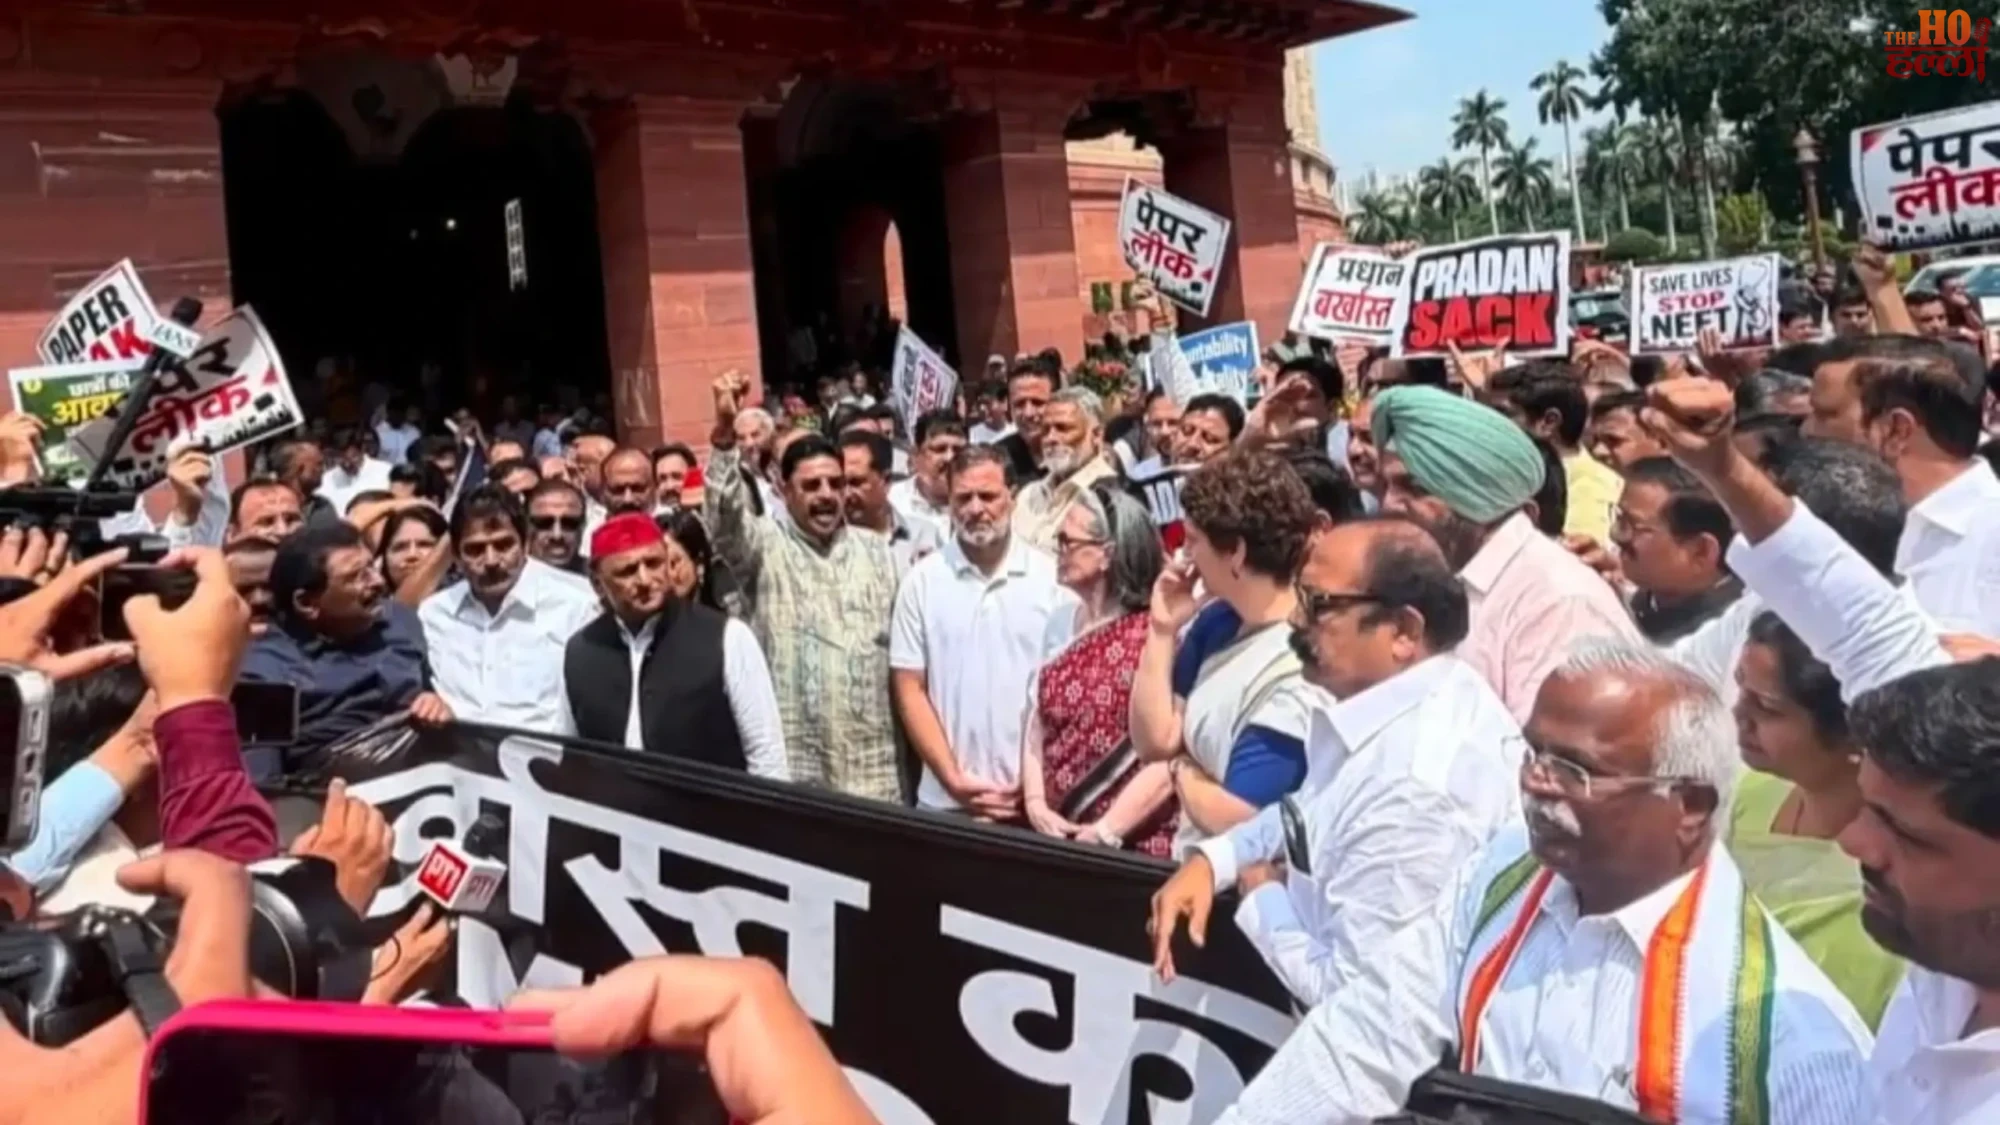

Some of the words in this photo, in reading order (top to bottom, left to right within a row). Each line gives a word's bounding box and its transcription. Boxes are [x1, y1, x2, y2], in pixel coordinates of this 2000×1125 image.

[1137, 191, 1207, 254] पेपर
[1131, 229, 1199, 279] लीक
[1336, 257, 1404, 287] प्रधान
[1414, 244, 1556, 302] PRADAN
[1650, 273, 1687, 294] SAVE
[1692, 267, 1733, 289] LIVES
[1658, 290, 1724, 314] STOP
[50, 283, 129, 364] PAPER
[153, 323, 194, 350] IANS
[1410, 292, 1553, 348] SACK
[131, 375, 251, 452] लीक
[423, 852, 461, 896] PTI
[465, 874, 497, 898] PTI
